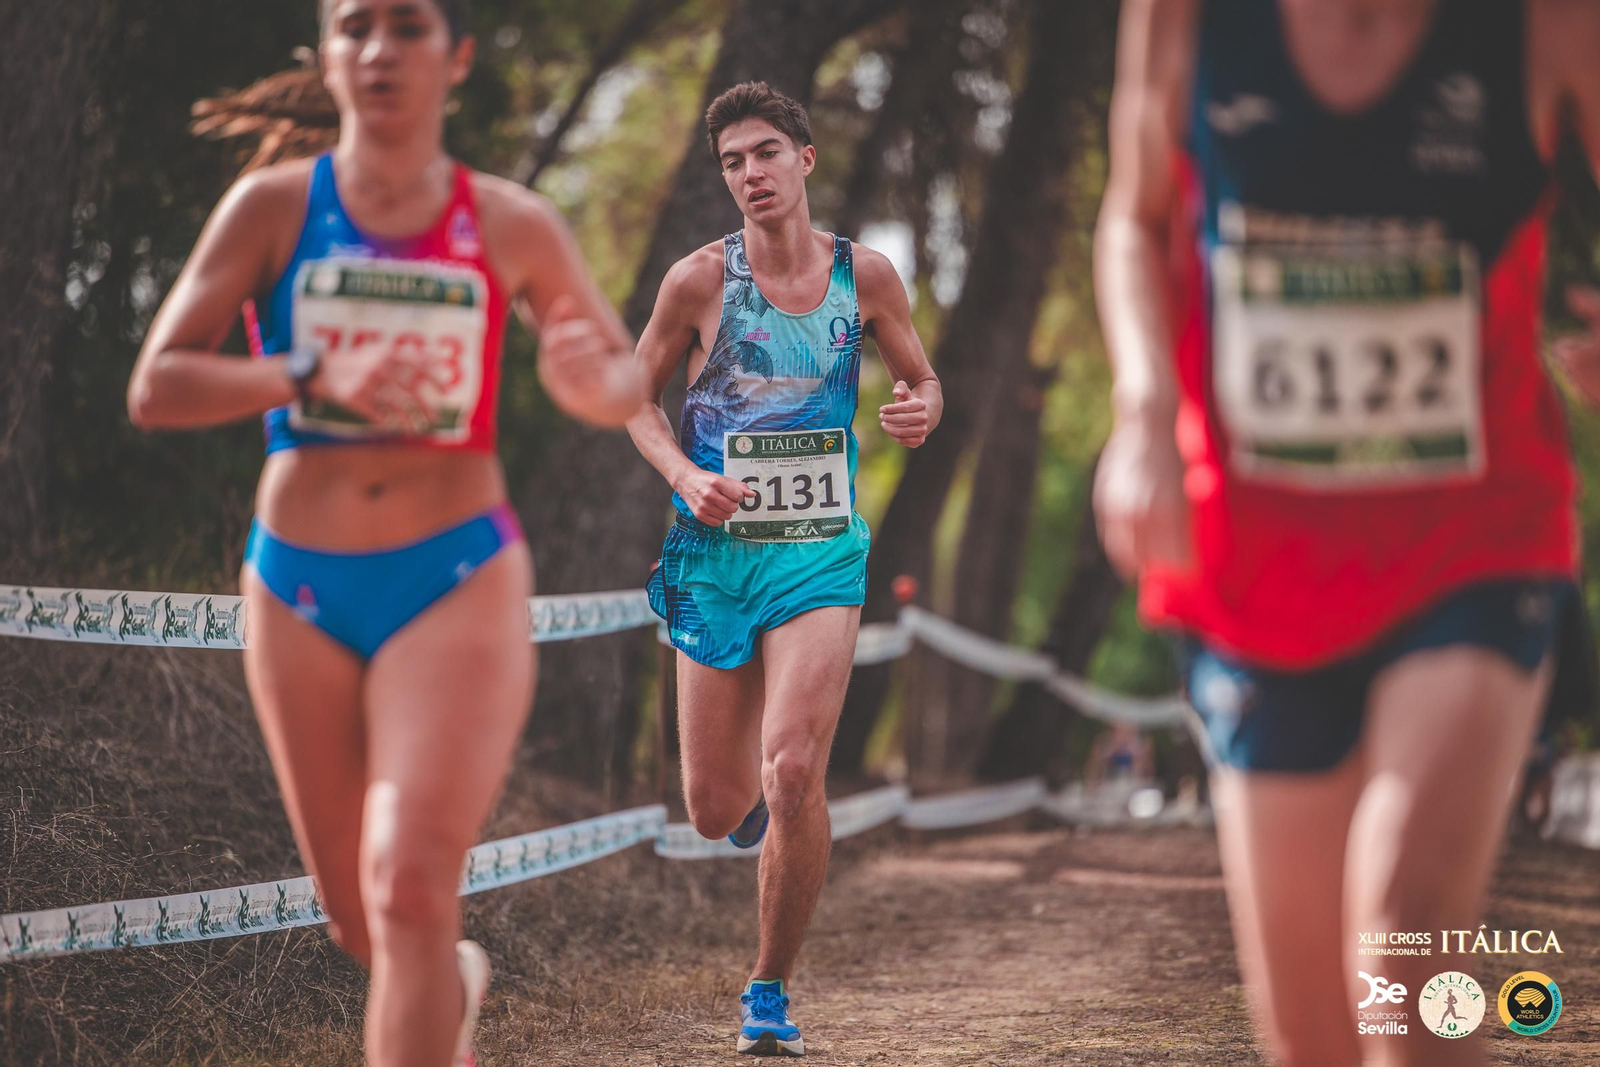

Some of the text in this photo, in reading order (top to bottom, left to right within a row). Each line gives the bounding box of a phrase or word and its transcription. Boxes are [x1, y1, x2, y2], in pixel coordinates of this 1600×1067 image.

[312, 325, 465, 388] 73
[746, 332, 771, 341] HORIZON
[1251, 335, 1454, 413] 6122
[762, 436, 817, 450] ITÁLICA
[739, 472, 841, 512] 6131
